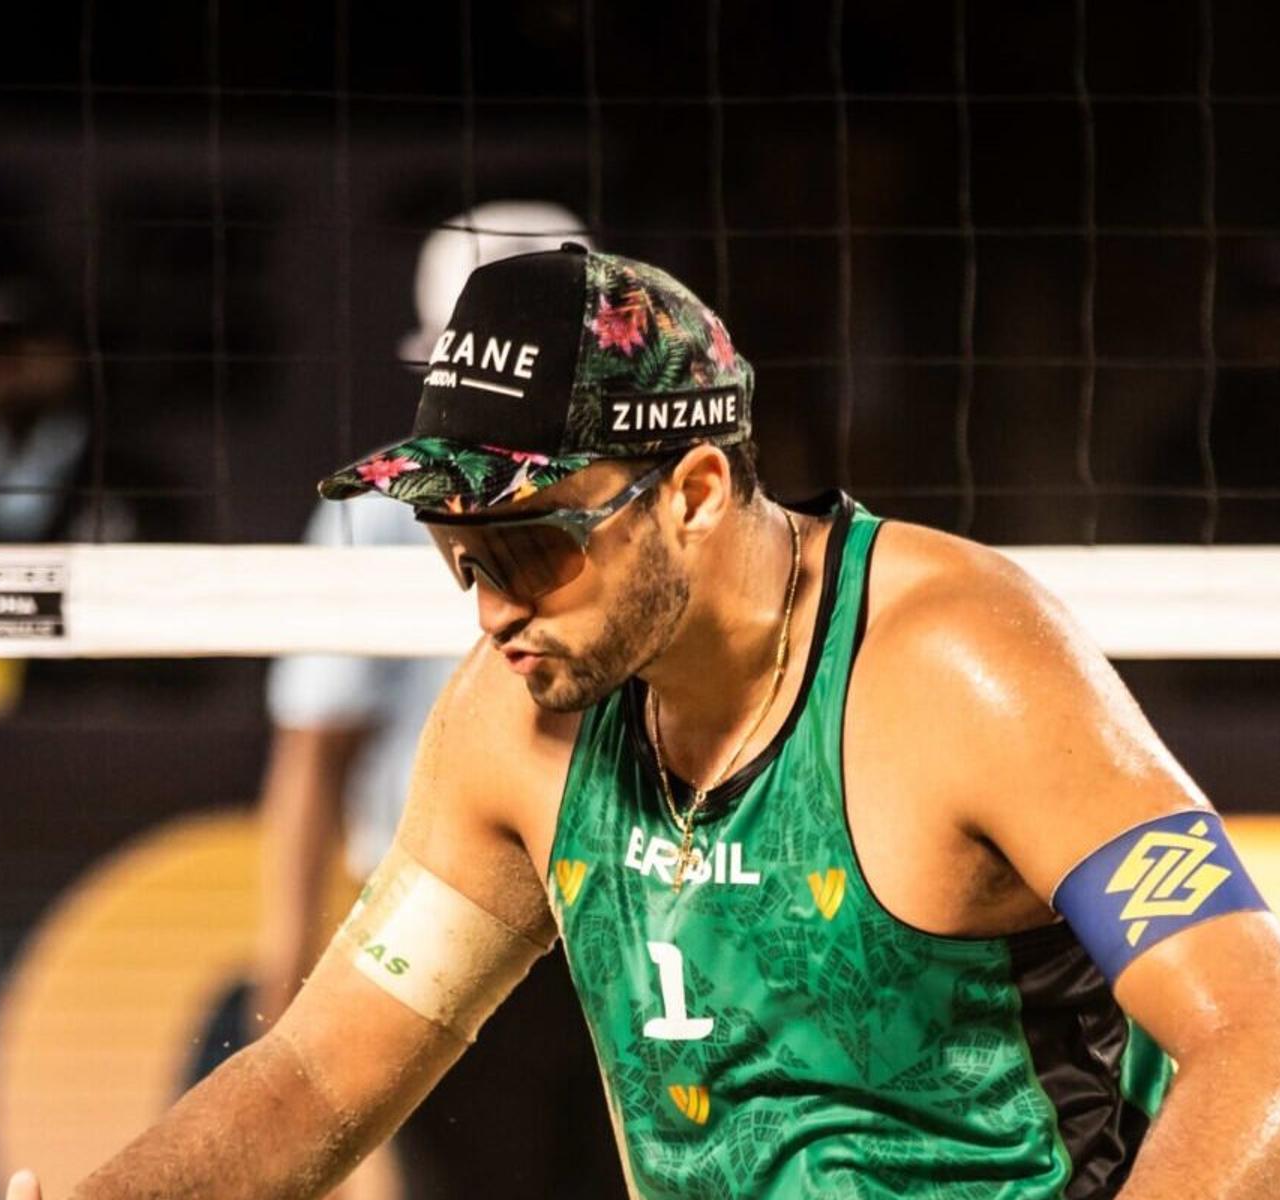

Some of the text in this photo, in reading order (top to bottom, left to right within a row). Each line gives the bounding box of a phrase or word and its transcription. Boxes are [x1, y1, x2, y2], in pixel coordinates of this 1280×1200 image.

[429, 329, 540, 379] ZANE
[612, 395, 737, 431] ZINZANE
[643, 941, 714, 1041] 1
